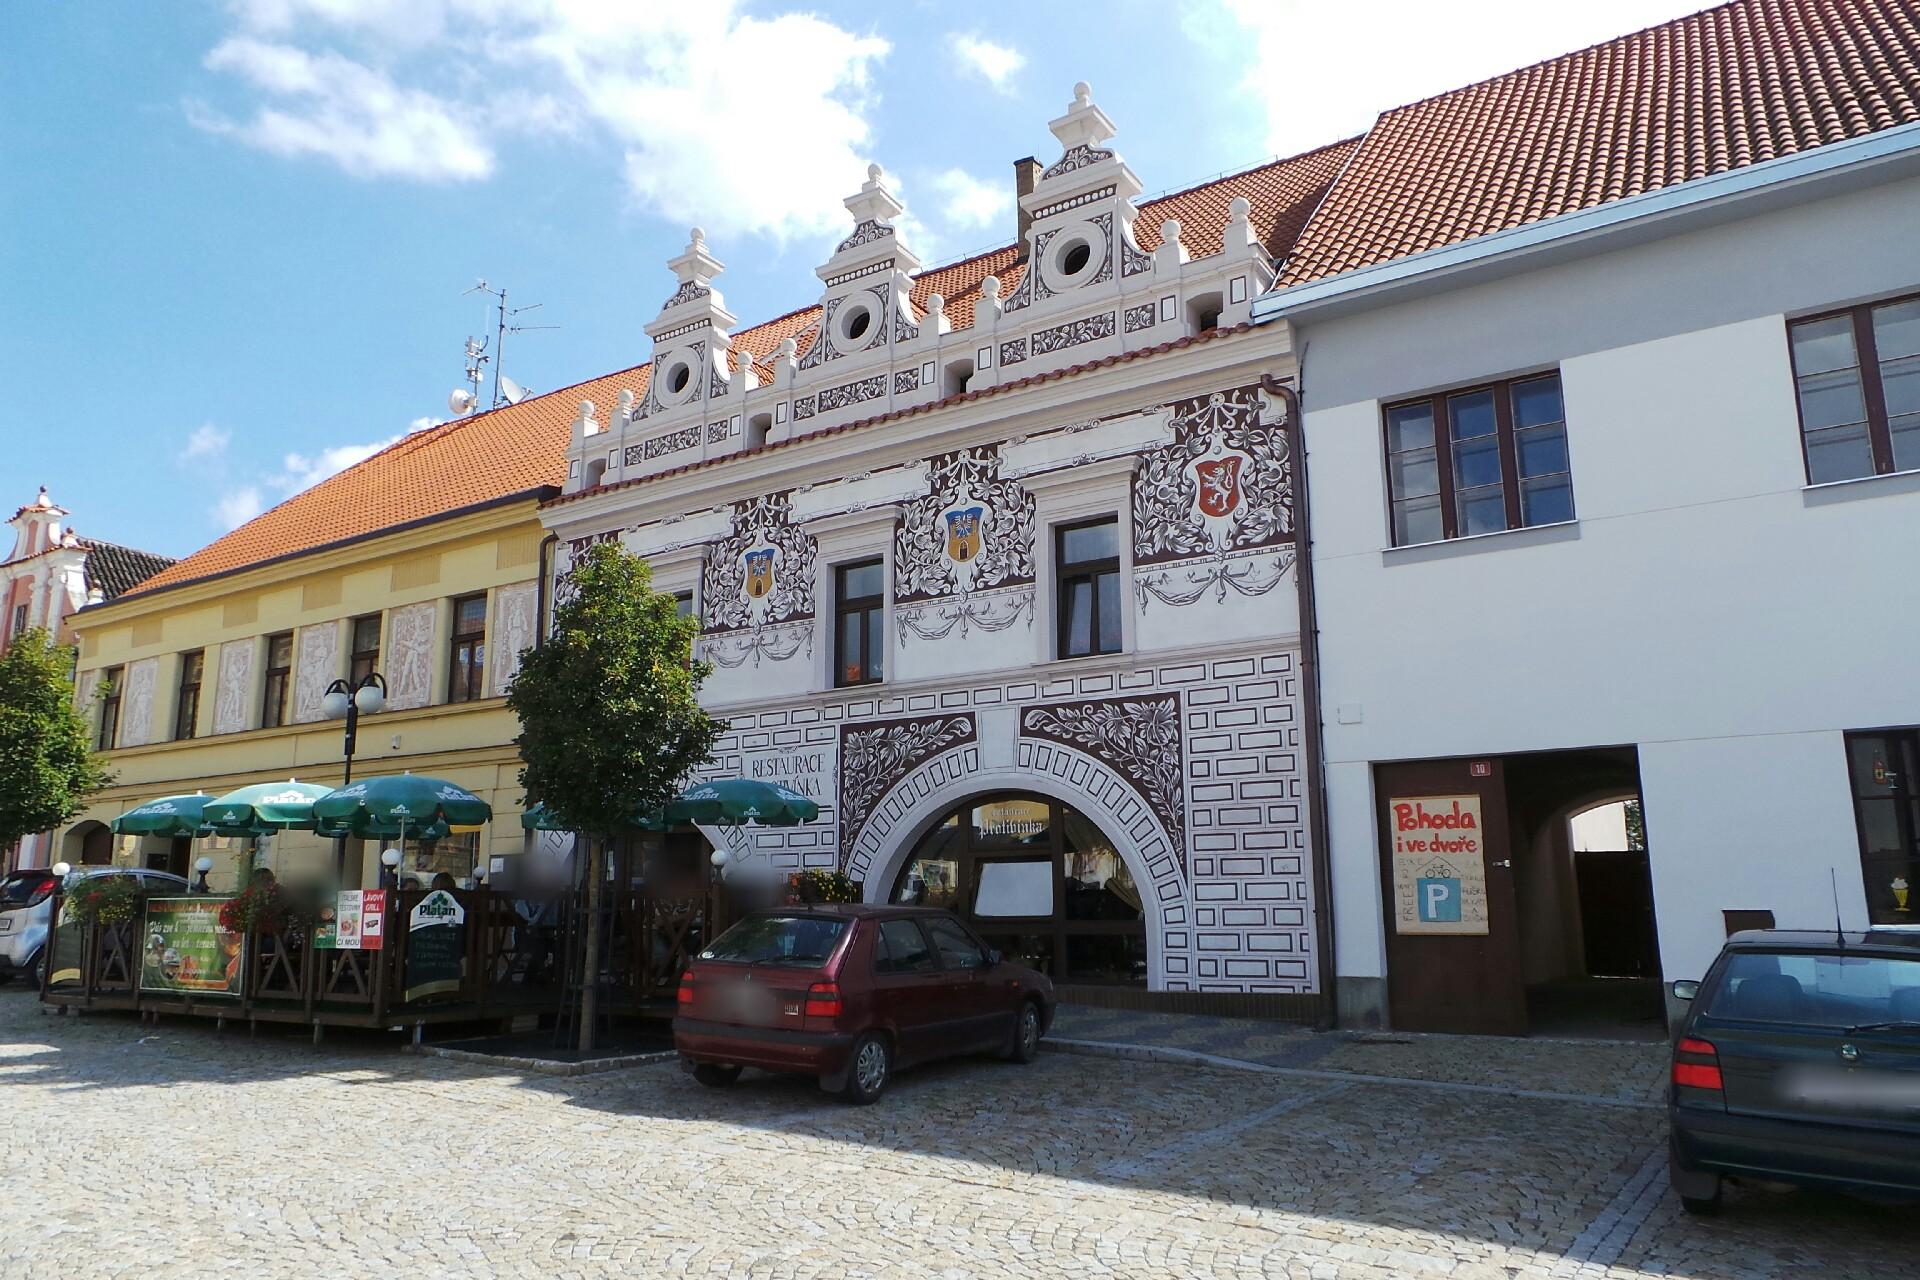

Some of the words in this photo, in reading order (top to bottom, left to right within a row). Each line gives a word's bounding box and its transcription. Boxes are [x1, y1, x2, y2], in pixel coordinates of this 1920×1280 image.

[752, 754, 826, 778] RESTAURACE
[1475, 764, 1485, 774] 10
[1393, 800, 1476, 831] Pohoda
[1397, 836, 1404, 853] i
[1406, 839, 1428, 853] ve
[1429, 832, 1478, 854] dvoře
[419, 904, 456, 916] Platan
[1426, 883, 1450, 919] P
